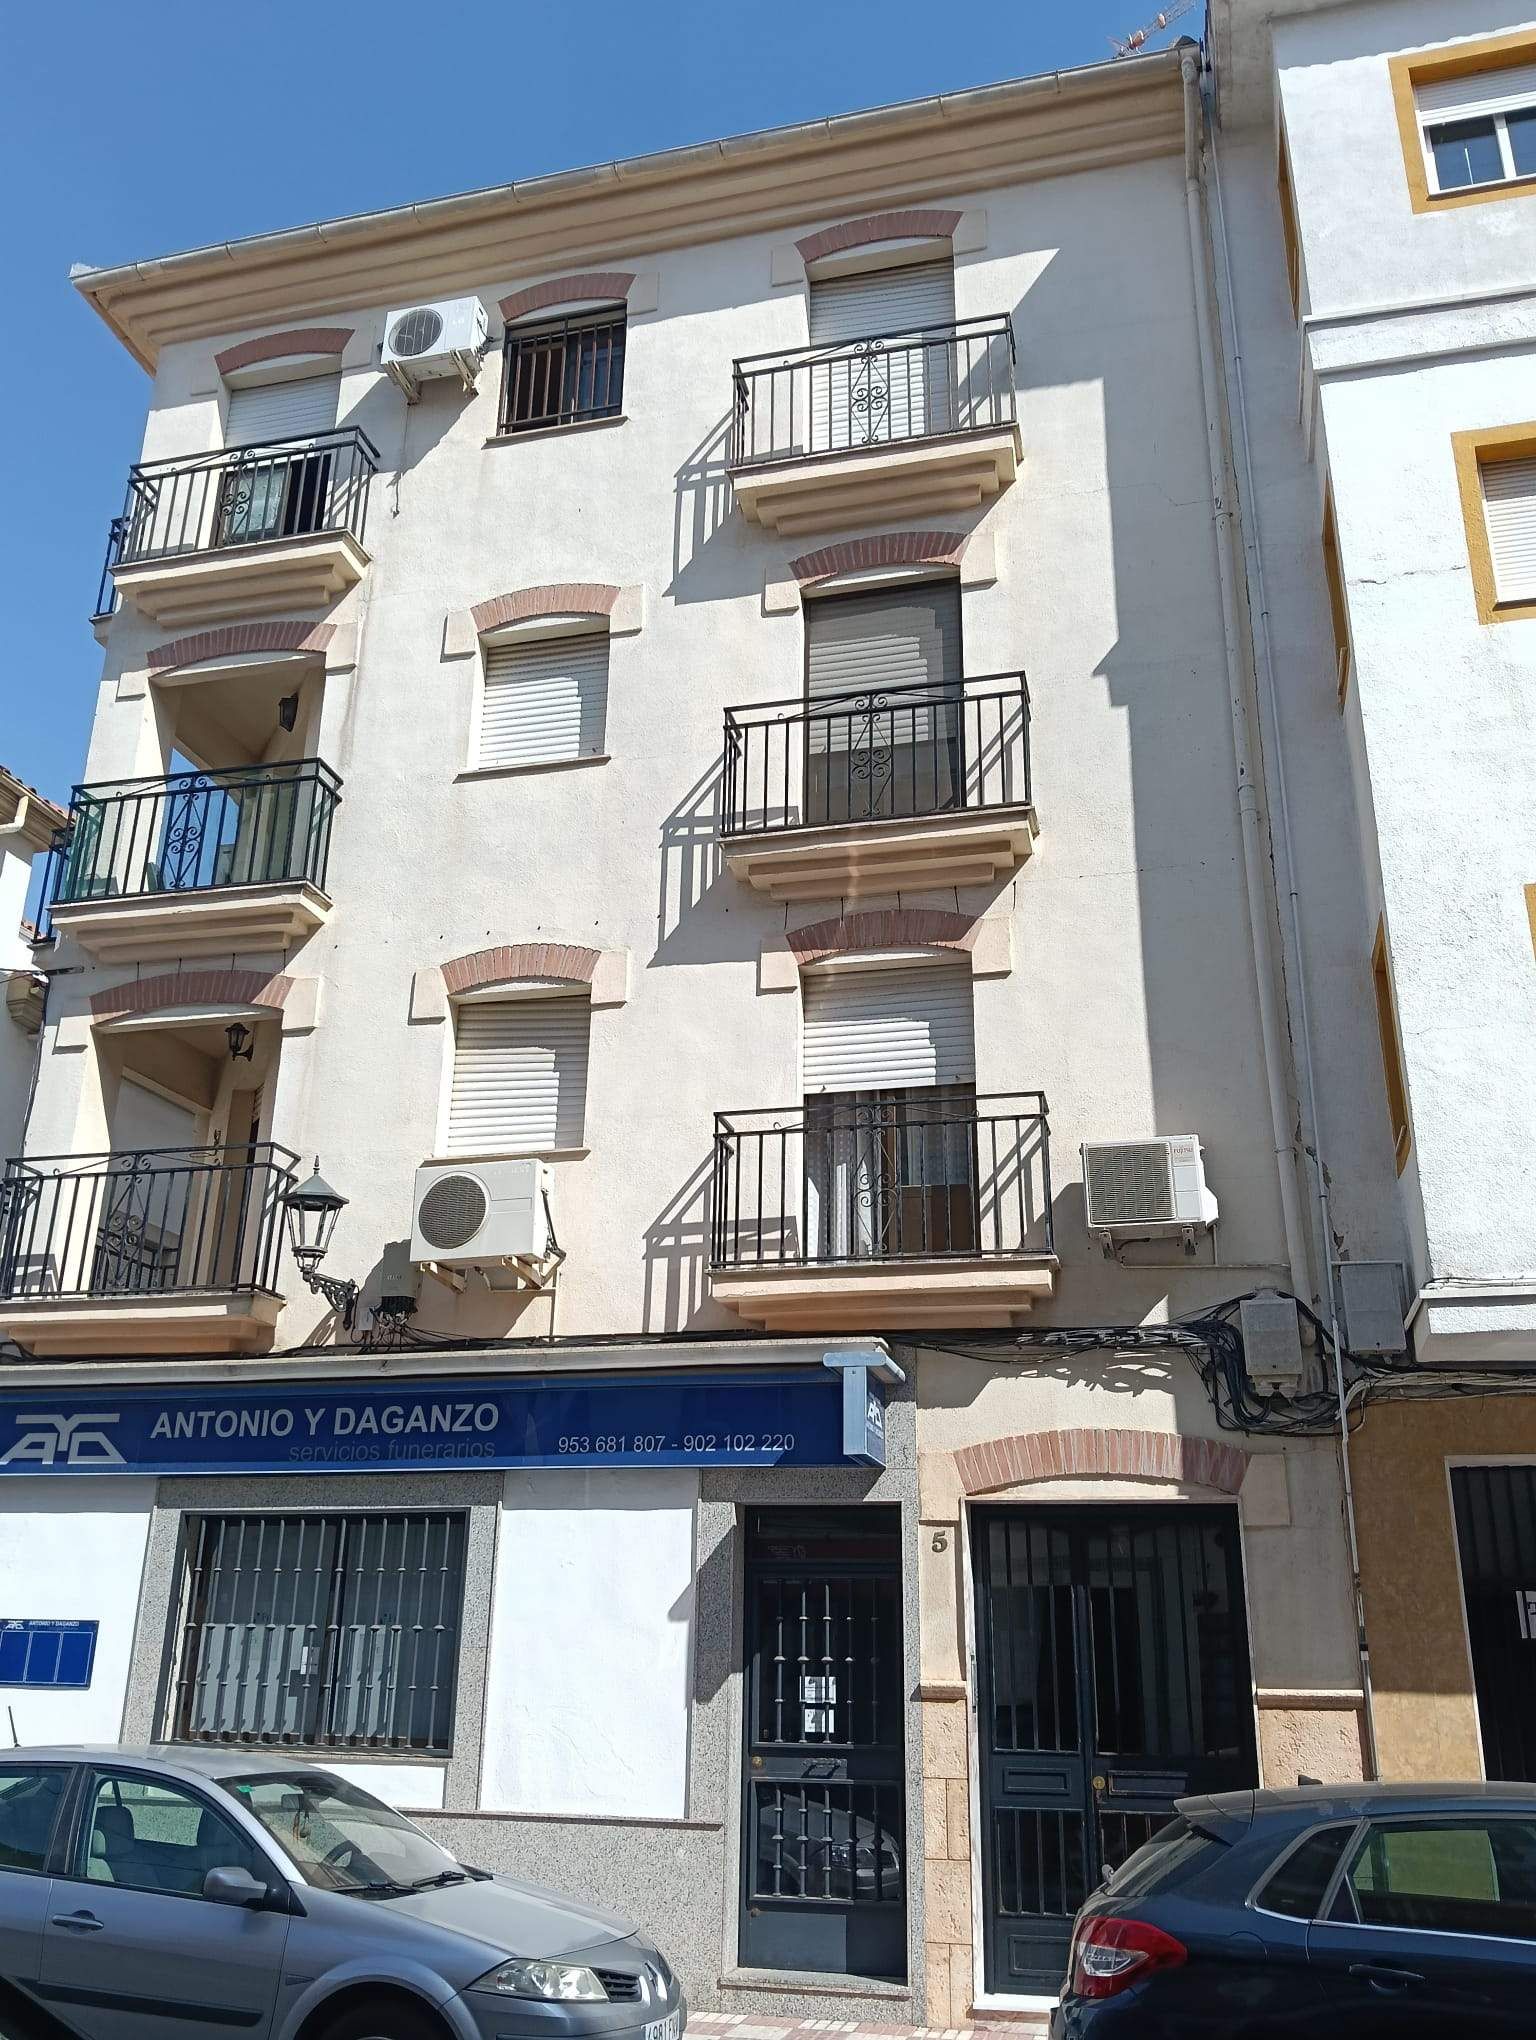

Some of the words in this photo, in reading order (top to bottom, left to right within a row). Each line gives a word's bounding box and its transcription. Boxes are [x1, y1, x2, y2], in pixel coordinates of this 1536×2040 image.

[150, 1408, 294, 1439] ANTONIO
[304, 1408, 326, 1436] Y
[333, 1398, 499, 1435] DAGANZO
[288, 1440, 380, 1463] servicios
[387, 1433, 496, 1460] funerarios
[558, 1436, 590, 1453] 953
[595, 1436, 626, 1453] 681
[633, 1435, 666, 1452] 807
[683, 1434, 717, 1452] 902
[723, 1434, 755, 1451] 102
[760, 1433, 796, 1451] 220
[931, 1530, 948, 1553] 5
